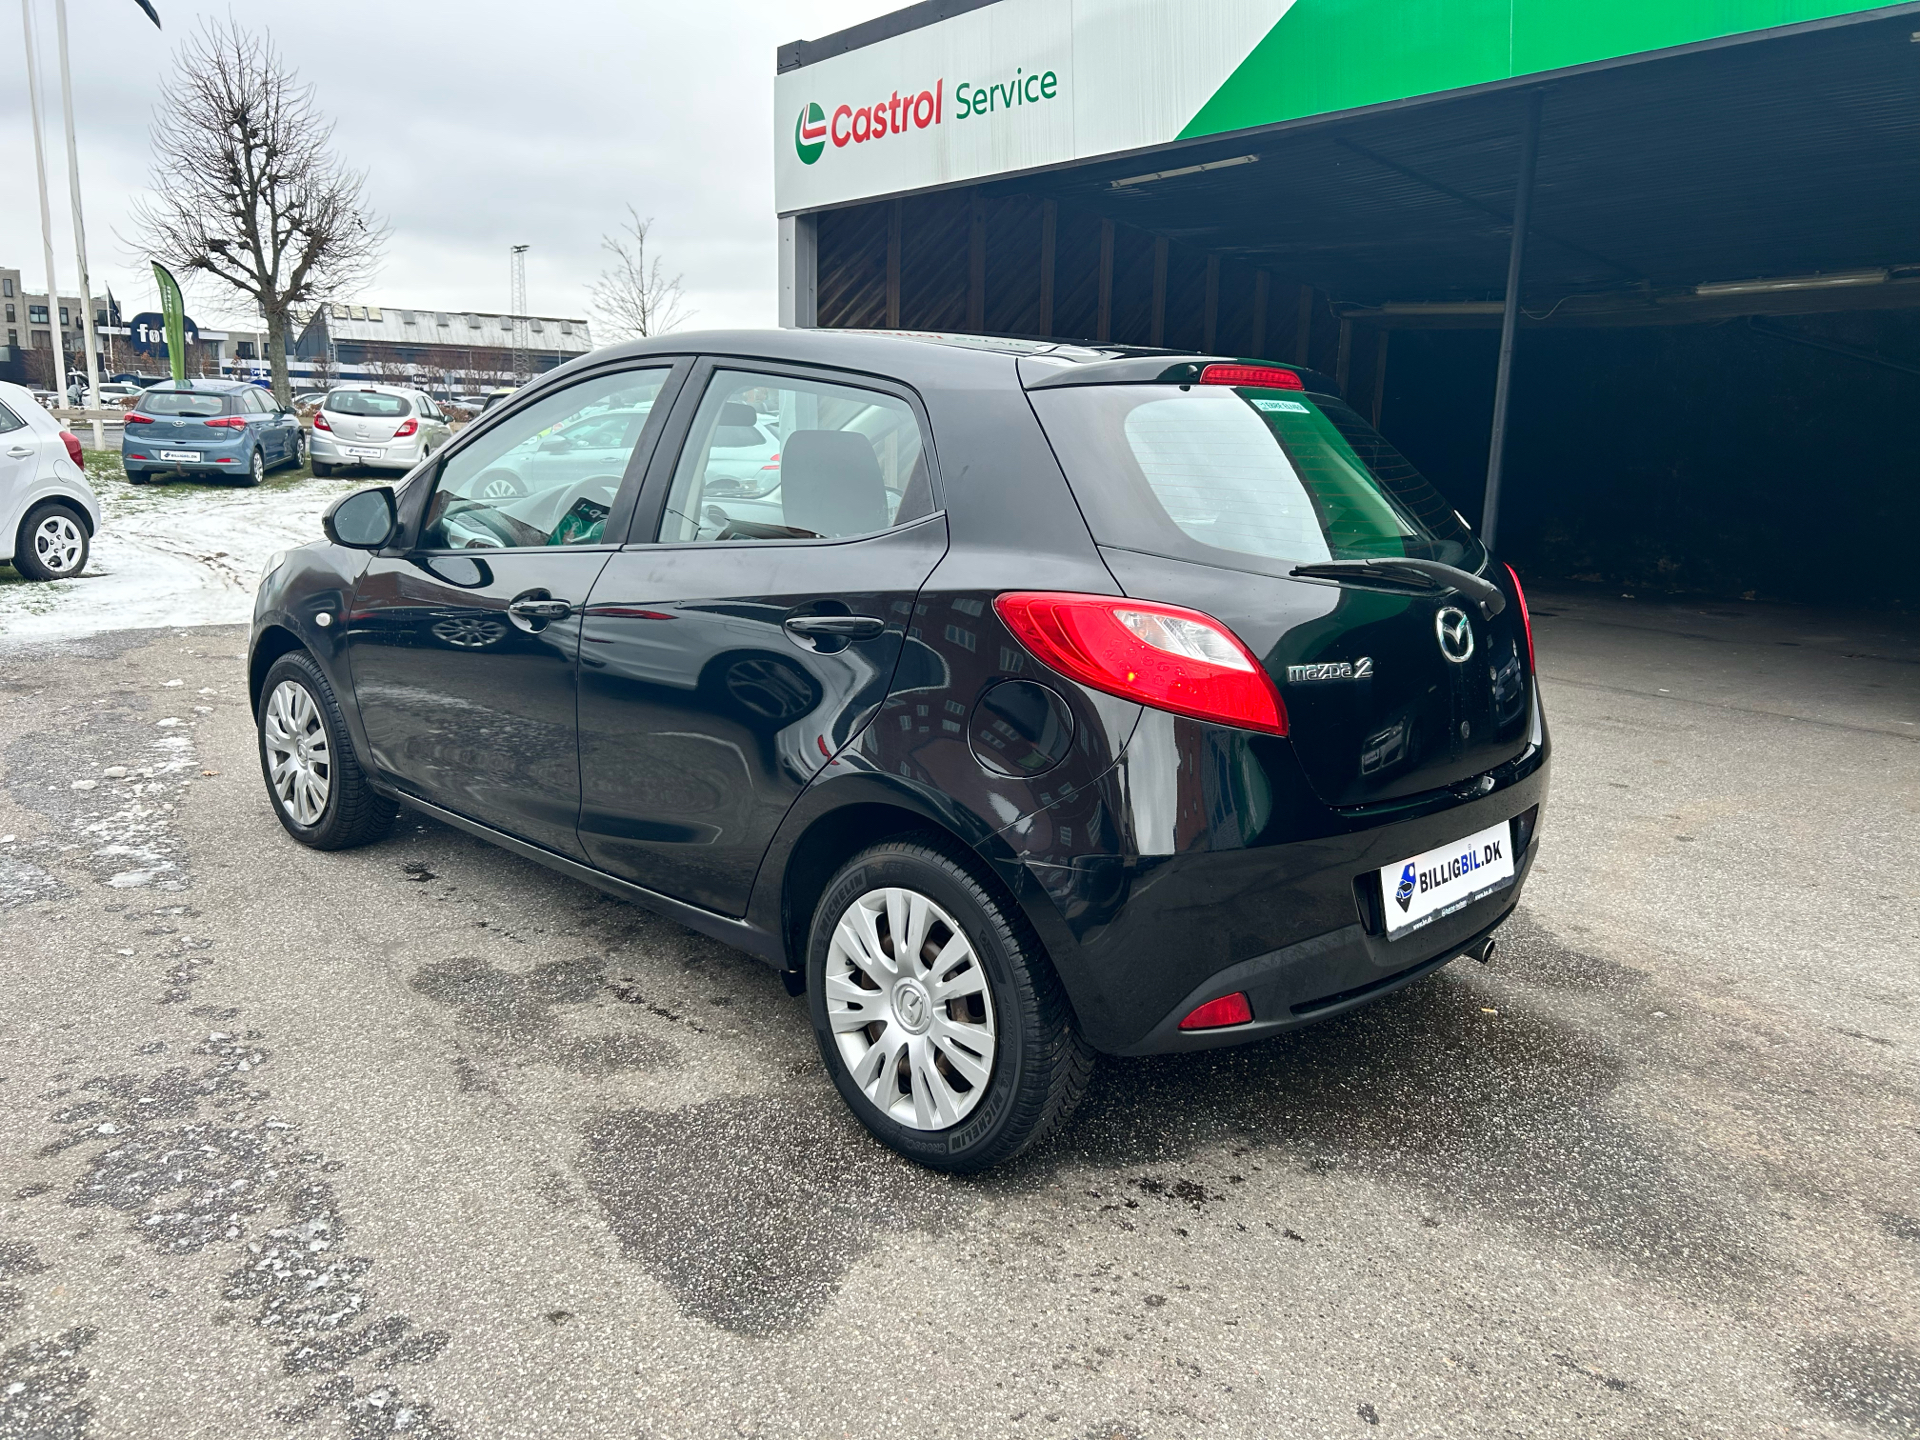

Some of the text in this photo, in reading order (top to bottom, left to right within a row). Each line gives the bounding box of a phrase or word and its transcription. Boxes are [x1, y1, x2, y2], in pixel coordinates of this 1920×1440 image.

[831, 67, 1058, 148] Castrol Service
[137, 323, 194, 345] føtx
[1419, 840, 1503, 893] BILLIGBIL.DK
[819, 873, 864, 936] MICHELIN
[950, 1089, 1004, 1151] MICHELIN
